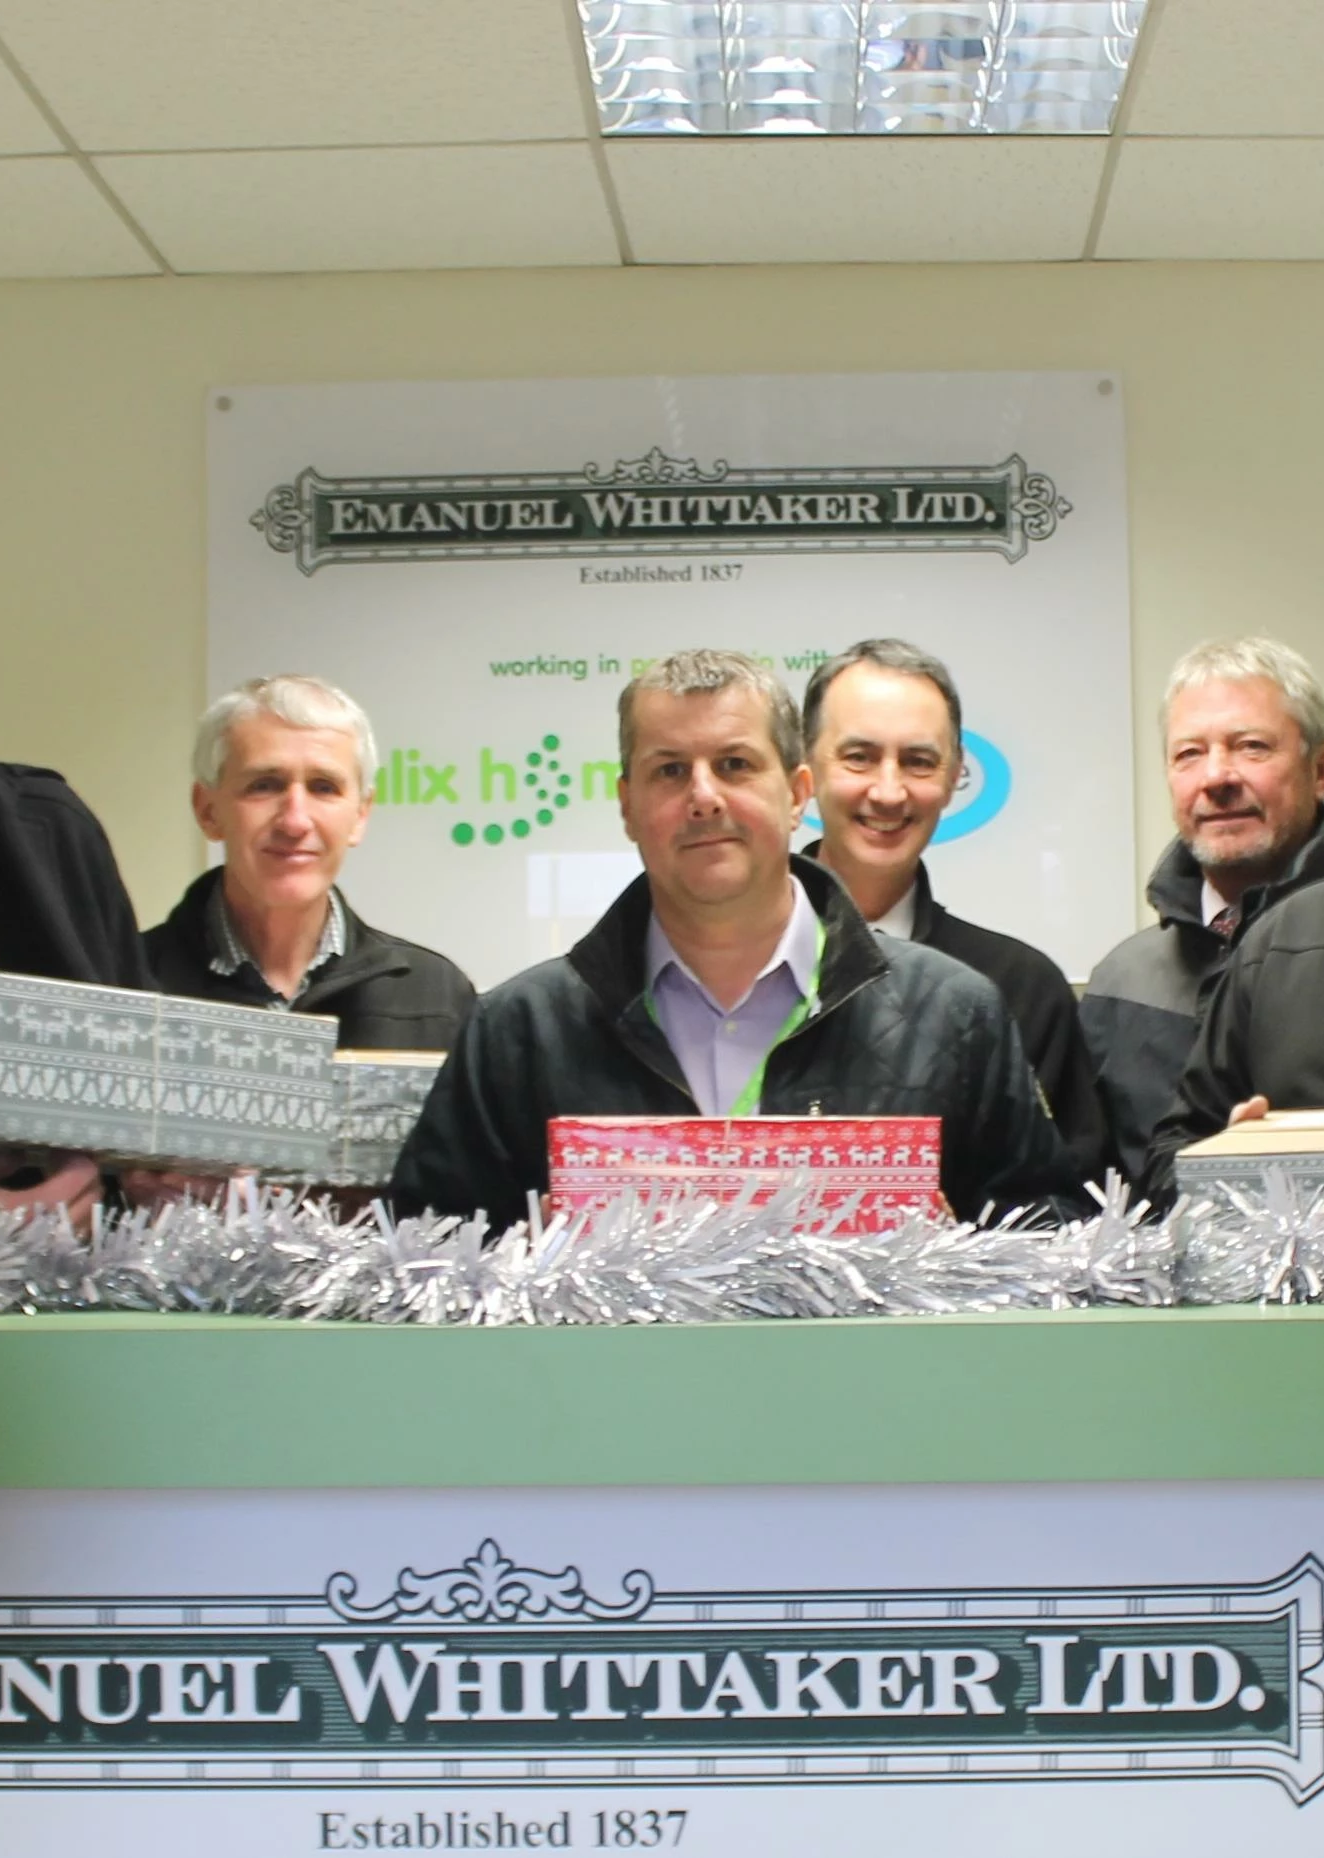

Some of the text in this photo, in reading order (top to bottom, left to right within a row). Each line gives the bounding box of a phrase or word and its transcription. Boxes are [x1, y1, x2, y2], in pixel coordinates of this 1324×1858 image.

[327, 487, 997, 535] EMANUEL WHITTAKER LTD.
[579, 563, 743, 585] Established 1837
[489, 654, 588, 680] working
[598, 652, 620, 674] in
[318, 1642, 1006, 1724] WHITTAKER
[1024, 1634, 1267, 1714] LTD.
[316, 1808, 689, 1852] Established 1837
